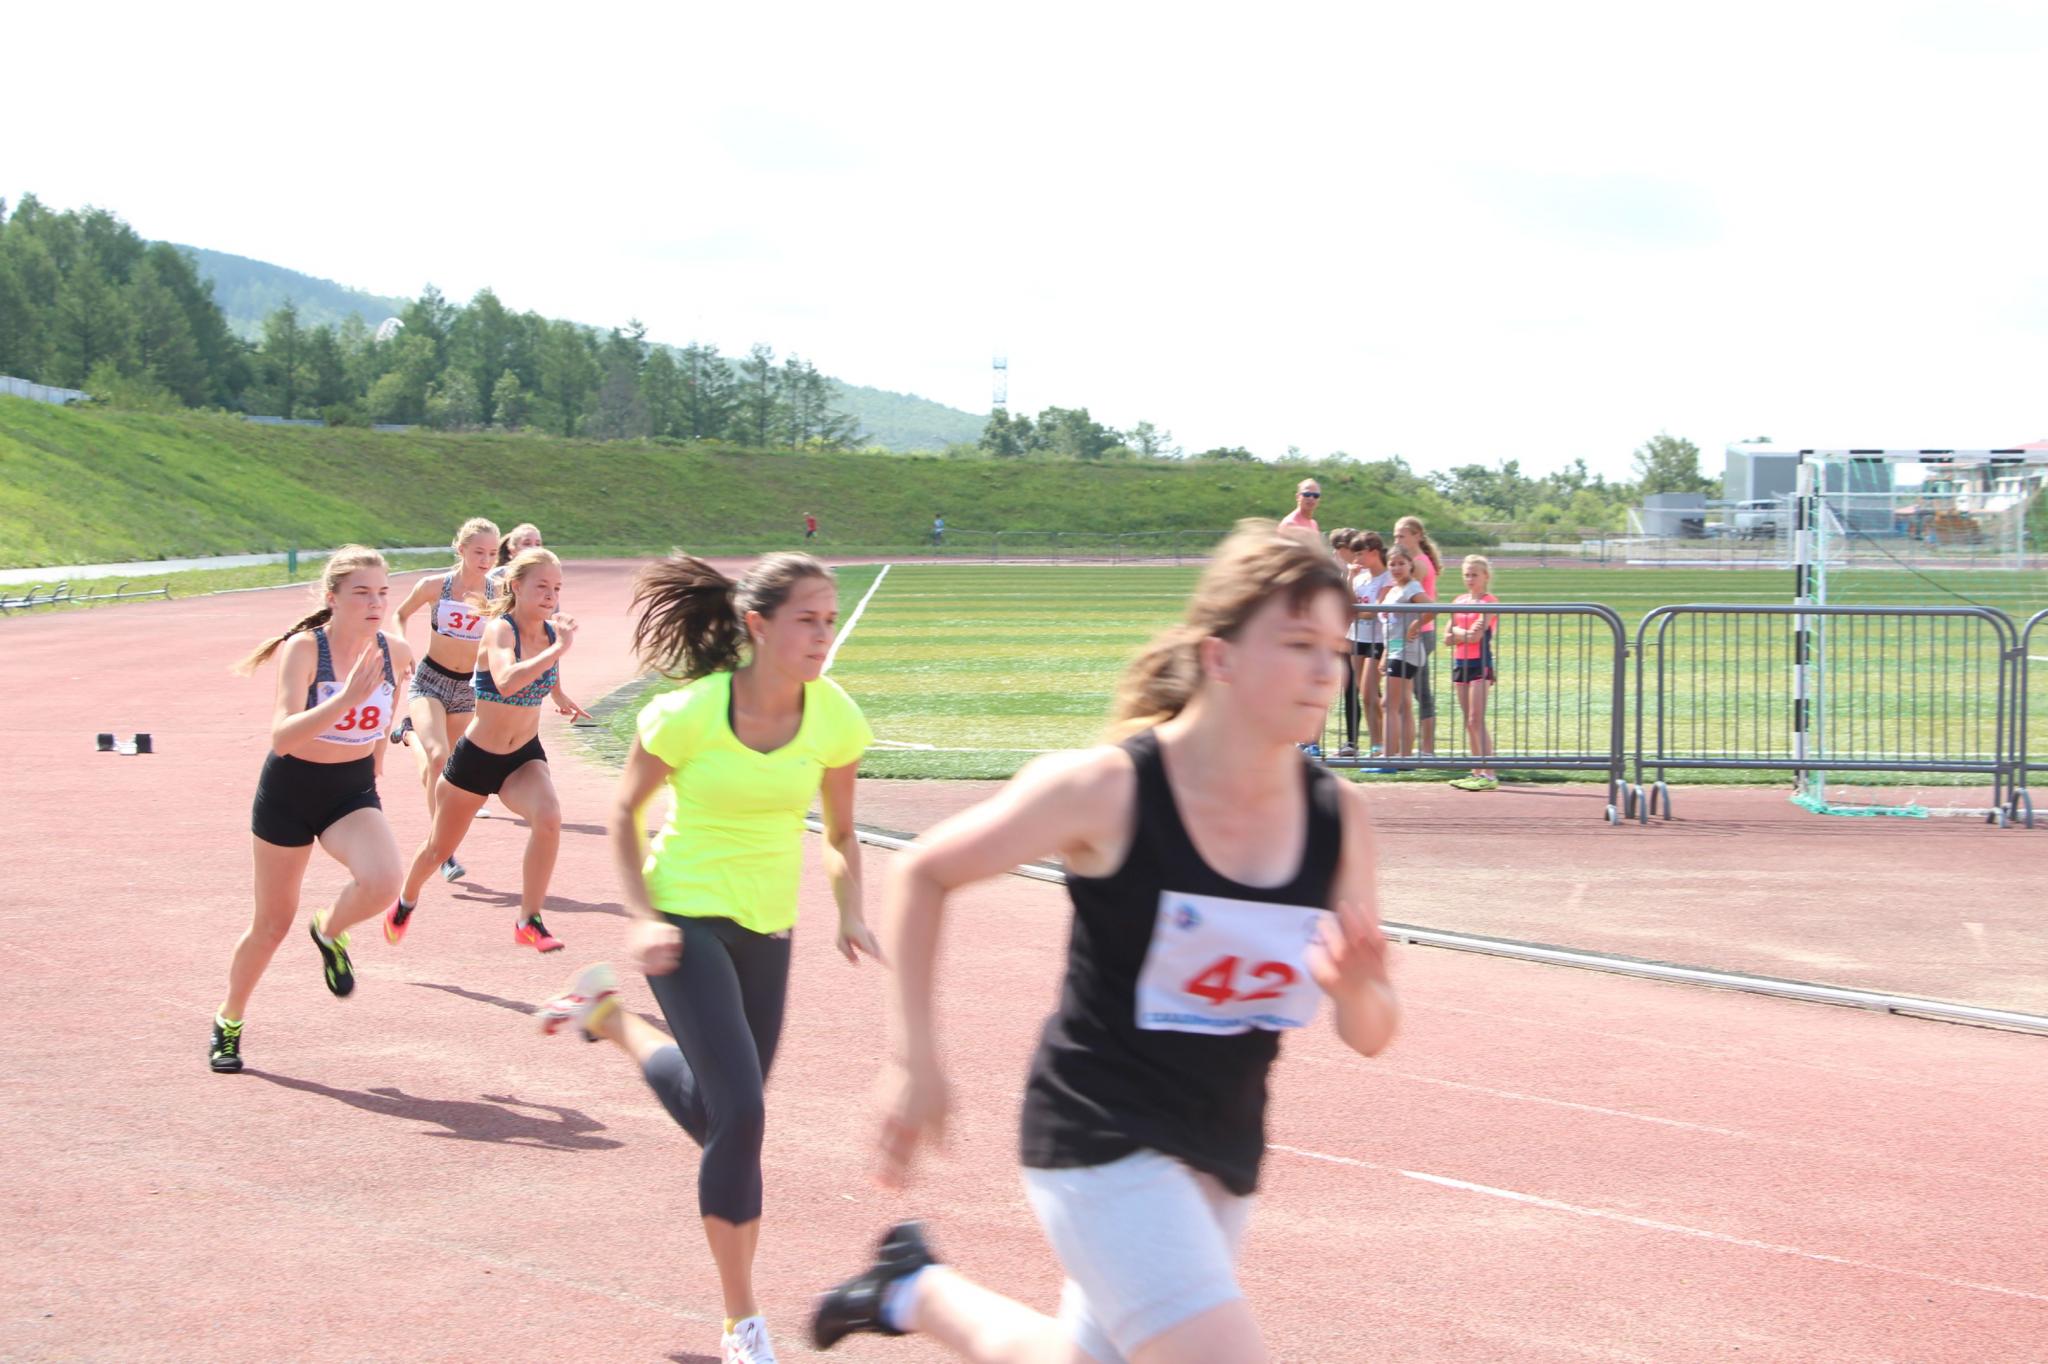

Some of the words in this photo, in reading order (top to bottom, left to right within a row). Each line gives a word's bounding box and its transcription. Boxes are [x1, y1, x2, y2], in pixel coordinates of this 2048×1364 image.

[448, 612, 481, 631] 37
[335, 706, 380, 731] 38
[1184, 955, 1299, 1005] 42
